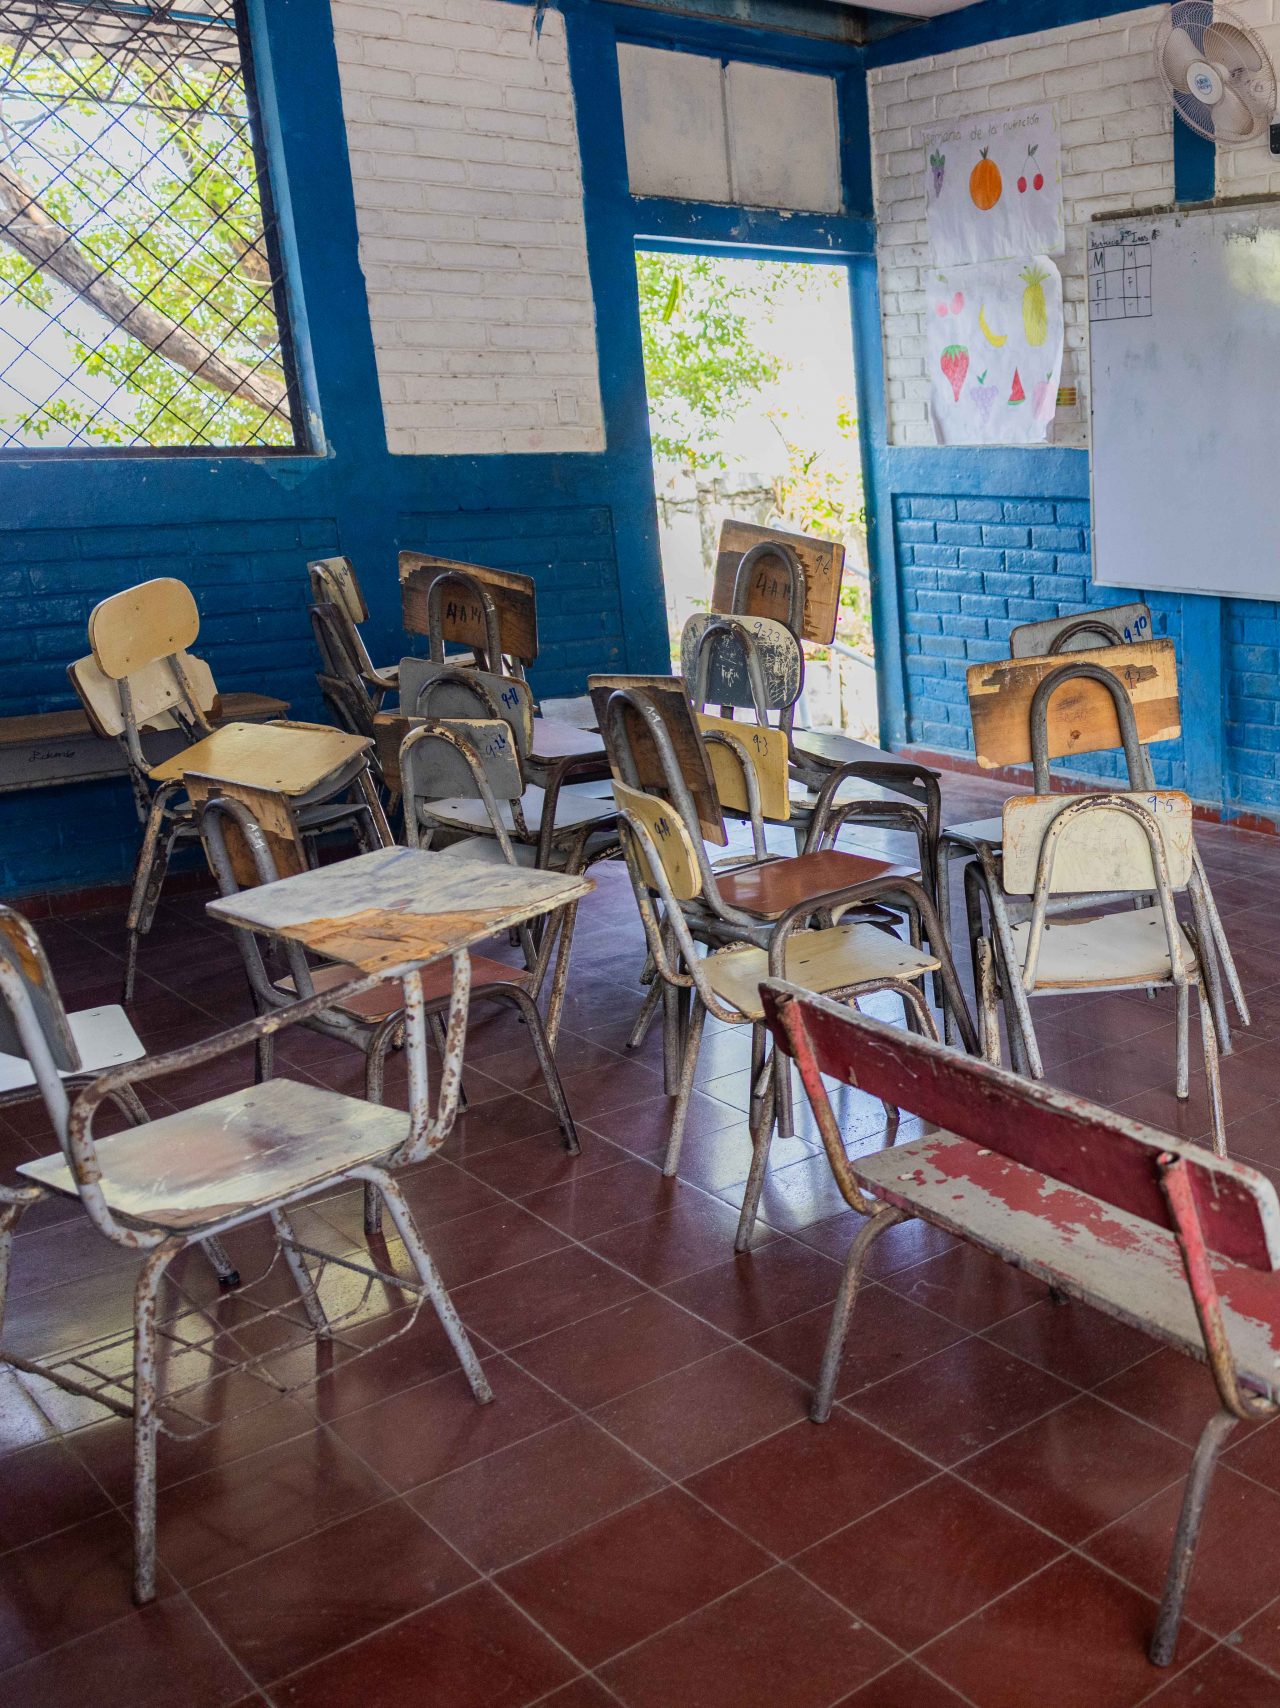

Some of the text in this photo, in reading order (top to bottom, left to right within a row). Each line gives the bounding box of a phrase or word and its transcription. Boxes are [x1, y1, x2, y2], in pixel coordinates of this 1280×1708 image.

[970, 125, 982, 140] de
[1093, 251, 1104, 268] M
[1096, 280, 1102, 297] F
[1124, 615, 1148, 644] 9-10
[752, 734, 769, 757] 9-3
[1147, 796, 1175, 814] 9-5
